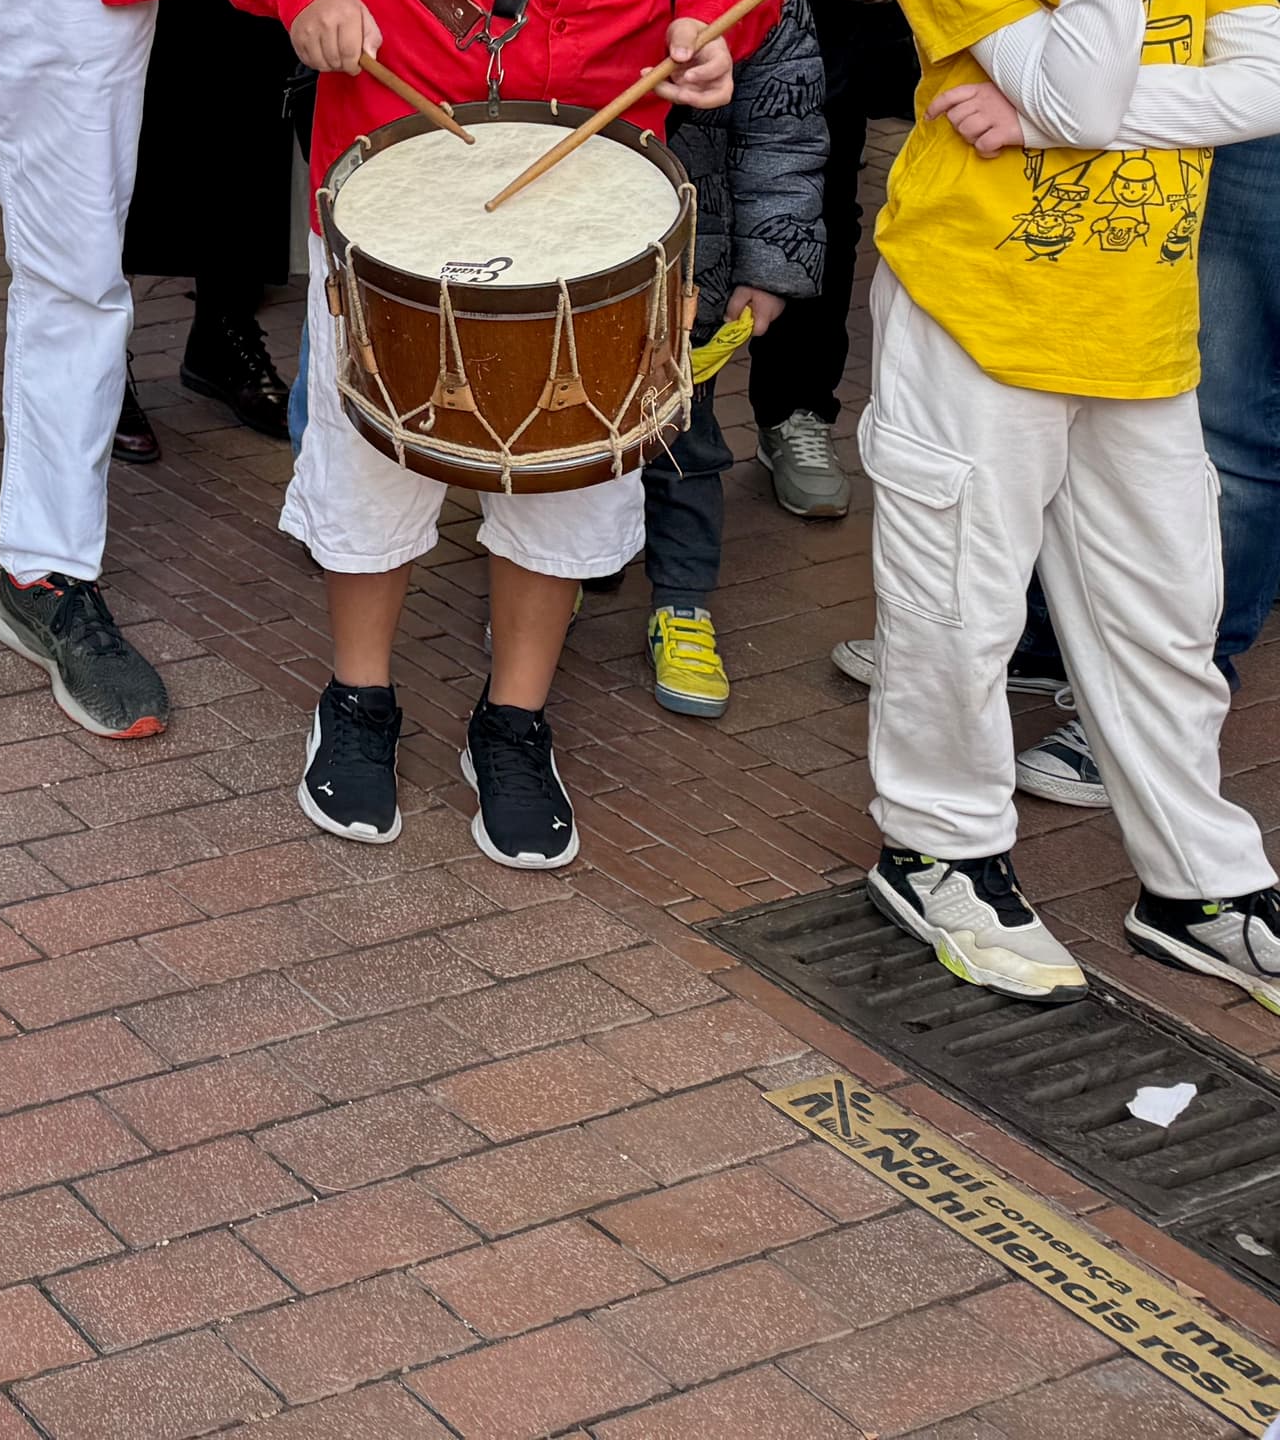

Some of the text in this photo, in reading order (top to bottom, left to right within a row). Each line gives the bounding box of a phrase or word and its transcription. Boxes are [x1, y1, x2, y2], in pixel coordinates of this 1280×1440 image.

[861, 1145, 1231, 1395] No hi llencis res
[876, 1127, 999, 1192] Aquí
[982, 1195, 1133, 1295] comença
[1135, 1297, 1177, 1320] el
